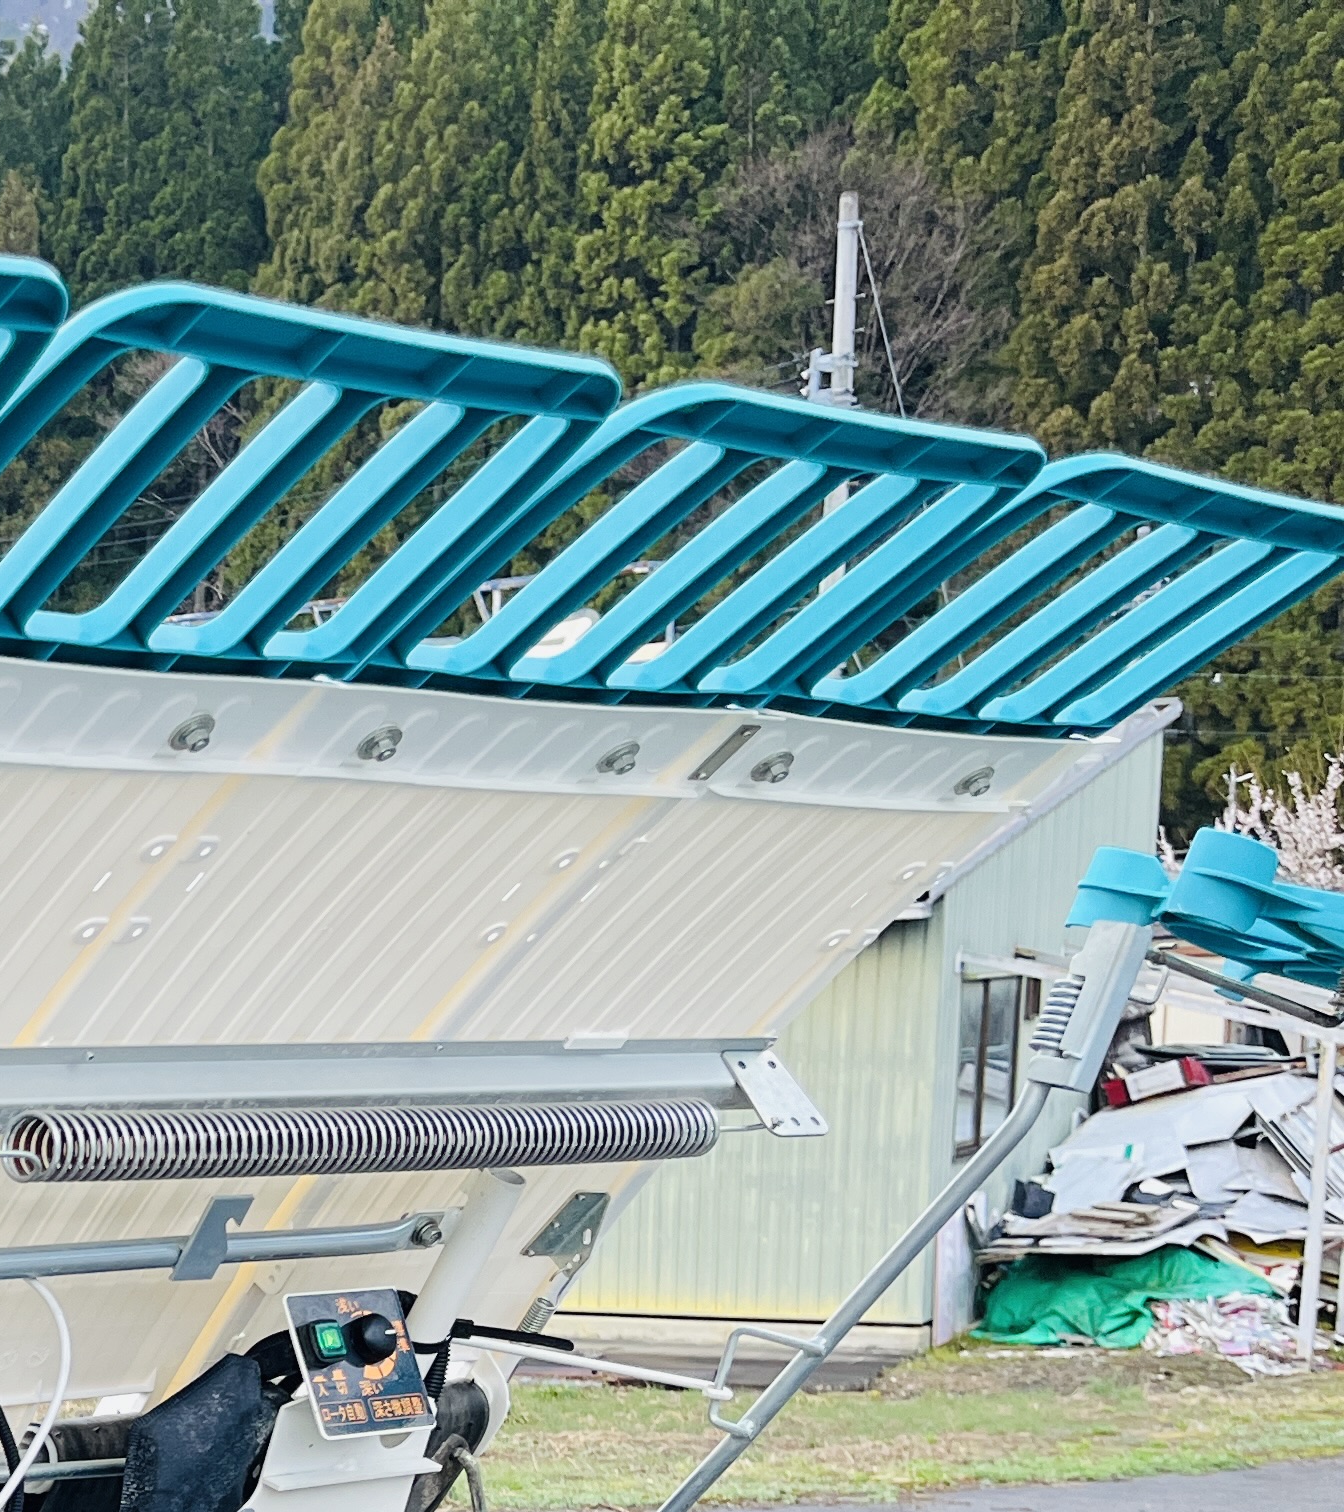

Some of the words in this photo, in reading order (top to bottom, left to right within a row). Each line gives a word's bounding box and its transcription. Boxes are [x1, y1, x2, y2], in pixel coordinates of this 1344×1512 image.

[335, 1296, 360, 1313] 浅い
[317, 1382, 330, 1398] 入
[359, 1380, 384, 1396] 深い
[321, 1402, 367, 1423] ロータ自動
